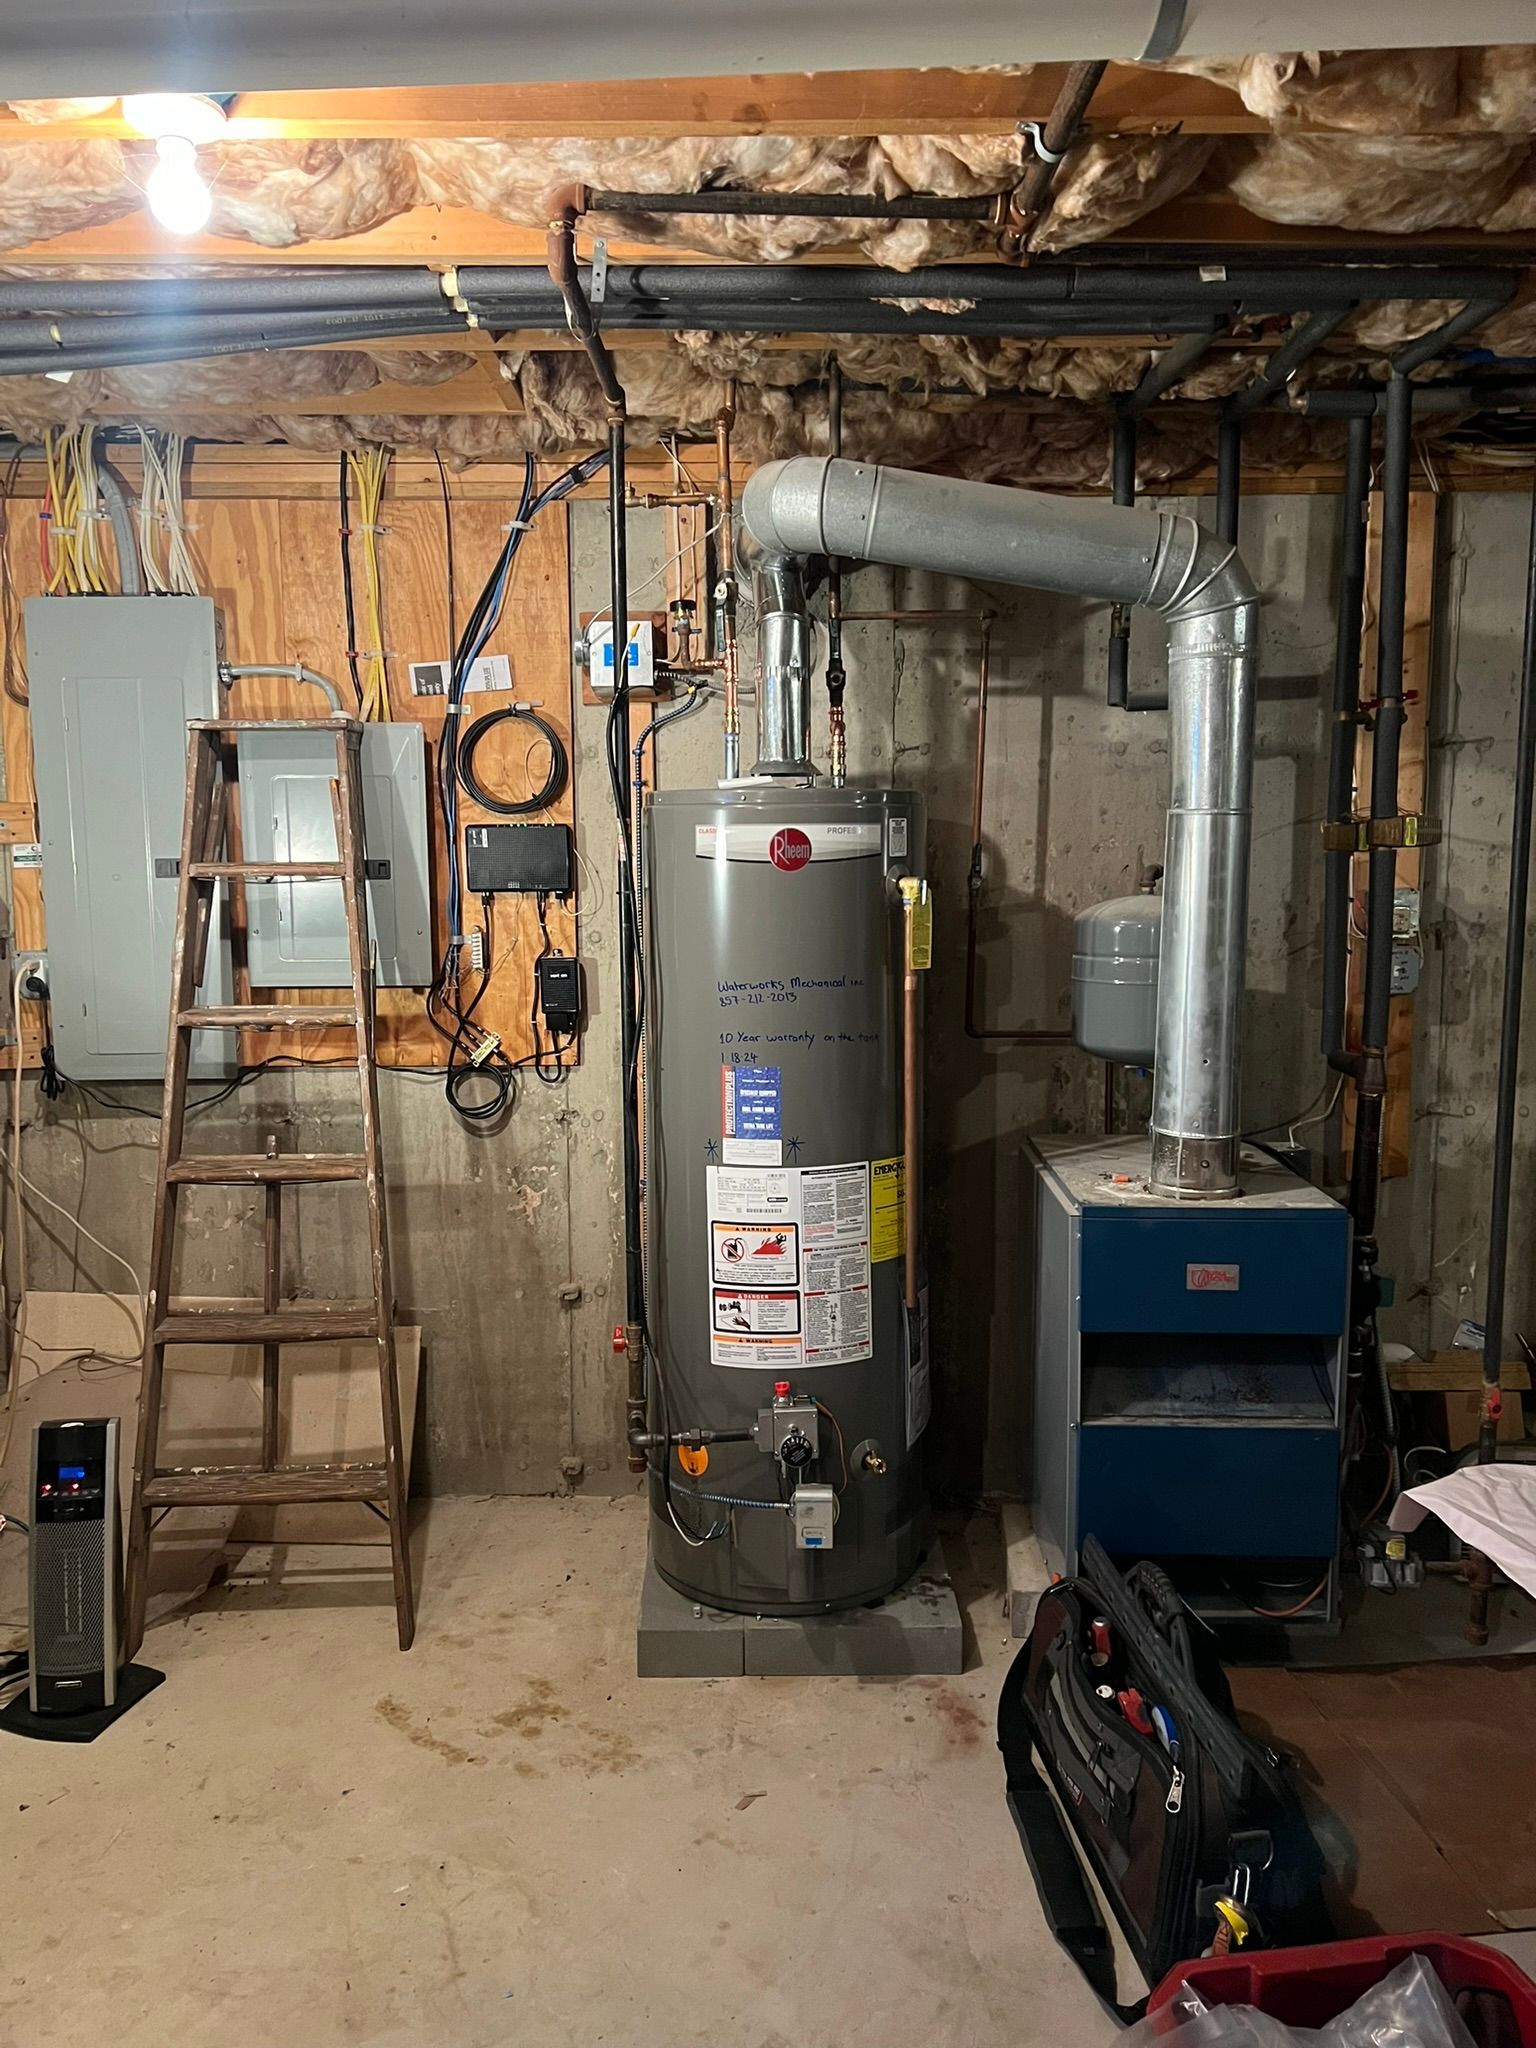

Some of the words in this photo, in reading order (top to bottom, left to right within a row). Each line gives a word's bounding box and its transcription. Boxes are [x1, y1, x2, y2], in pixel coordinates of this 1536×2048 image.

[773, 828, 811, 866] Rheem
[717, 978, 785, 993] Waterworks
[790, 975, 846, 990] Mechanical
[719, 1032, 734, 1044] 10
[737, 1031, 761, 1043] Year
[766, 1030, 816, 1050] warranty
[823, 1034, 836, 1044] on
[837, 1031, 855, 1042] the
